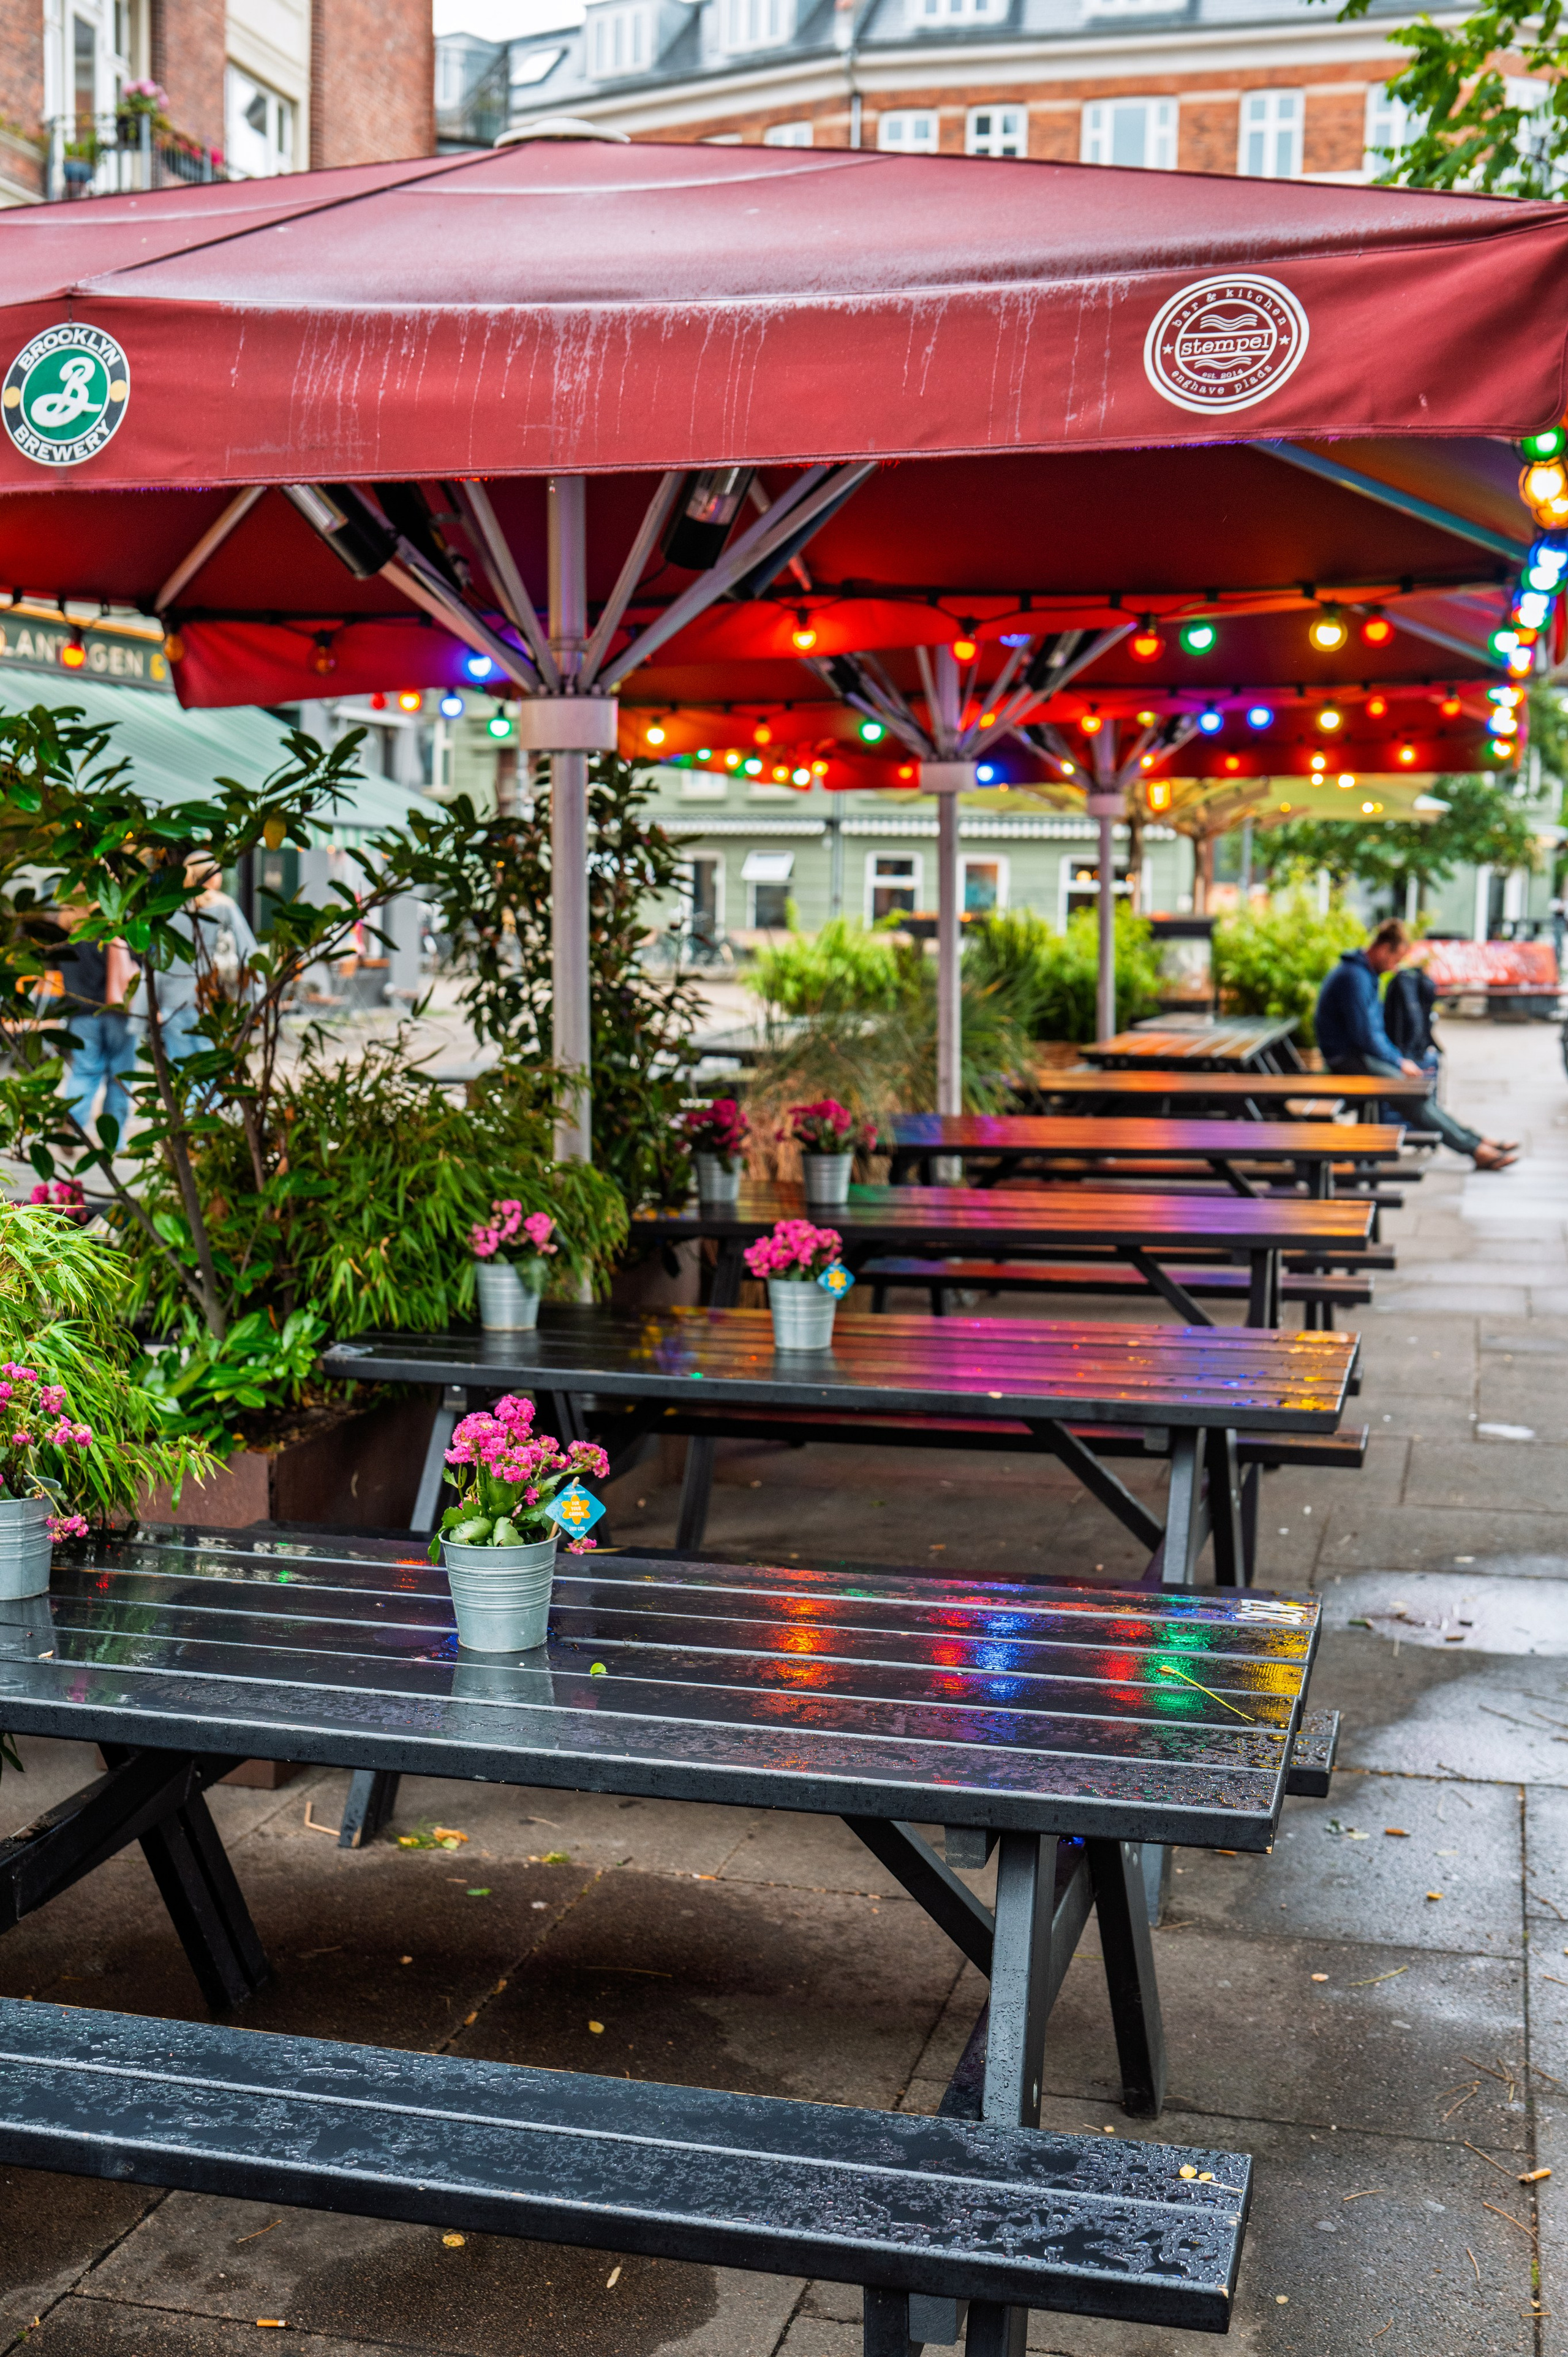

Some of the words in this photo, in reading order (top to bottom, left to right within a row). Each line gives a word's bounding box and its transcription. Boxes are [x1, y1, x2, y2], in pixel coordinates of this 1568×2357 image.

[1172, 301, 1199, 328] bar
[1206, 293, 1216, 303] &
[1226, 289, 1287, 325] kitchen
[18, 328, 121, 371] BROOKLYN
[1180, 333, 1269, 356] stempel
[1171, 370, 1225, 395] enghave
[1234, 365, 1272, 394] plads
[1220, 369, 1244, 379] 2014
[13, 418, 110, 461] BREWERY
